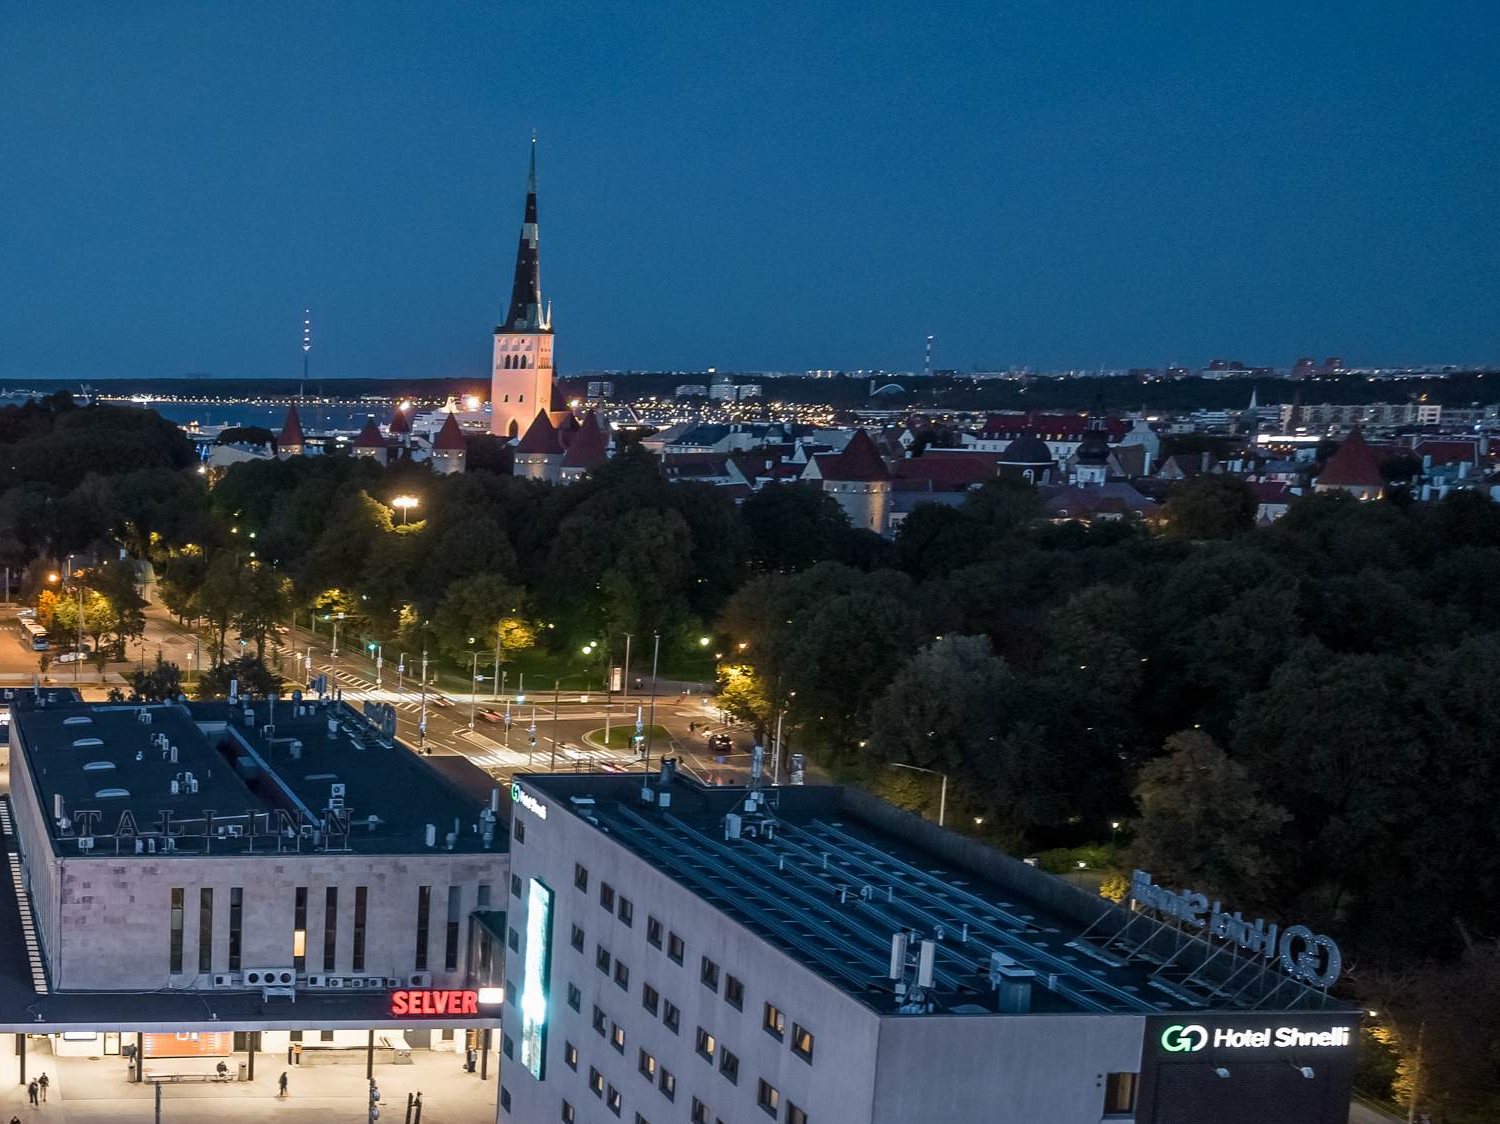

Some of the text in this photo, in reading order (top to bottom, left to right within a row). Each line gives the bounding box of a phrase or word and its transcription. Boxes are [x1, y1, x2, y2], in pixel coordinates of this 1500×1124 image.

[74, 808, 354, 837] TALLINN
[392, 990, 478, 1015] SELVER
[1213, 1028, 1271, 1048] Hotel
[1274, 1026, 1350, 1048] Shnelli
